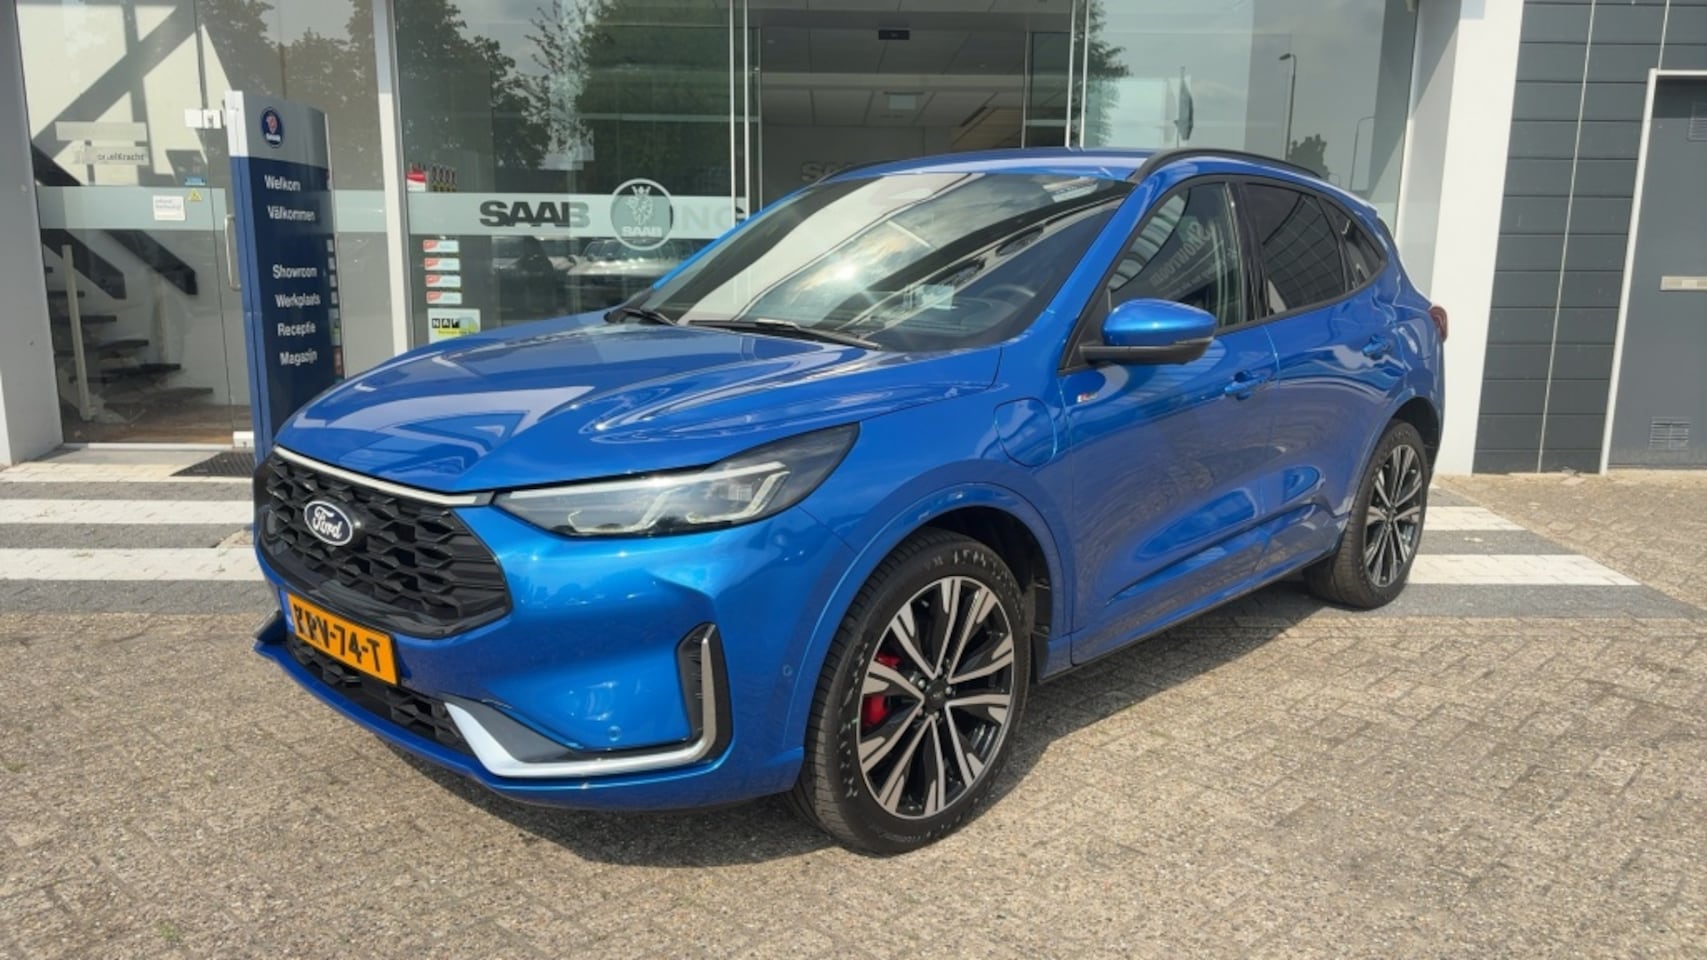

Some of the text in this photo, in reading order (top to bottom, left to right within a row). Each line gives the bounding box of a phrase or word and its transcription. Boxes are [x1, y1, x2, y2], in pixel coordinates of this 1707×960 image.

[264, 174, 301, 191] Welkom
[267, 205, 316, 221] Välkommen
[479, 200, 591, 228] SAAB
[621, 226, 663, 237] SAAB
[272, 263, 318, 279] Showroom
[274, 292, 321, 309] Werkplaats
[277, 321, 317, 337] Receptie
[279, 348, 318, 366] Magazijn
[312, 505, 343, 539] Ford
